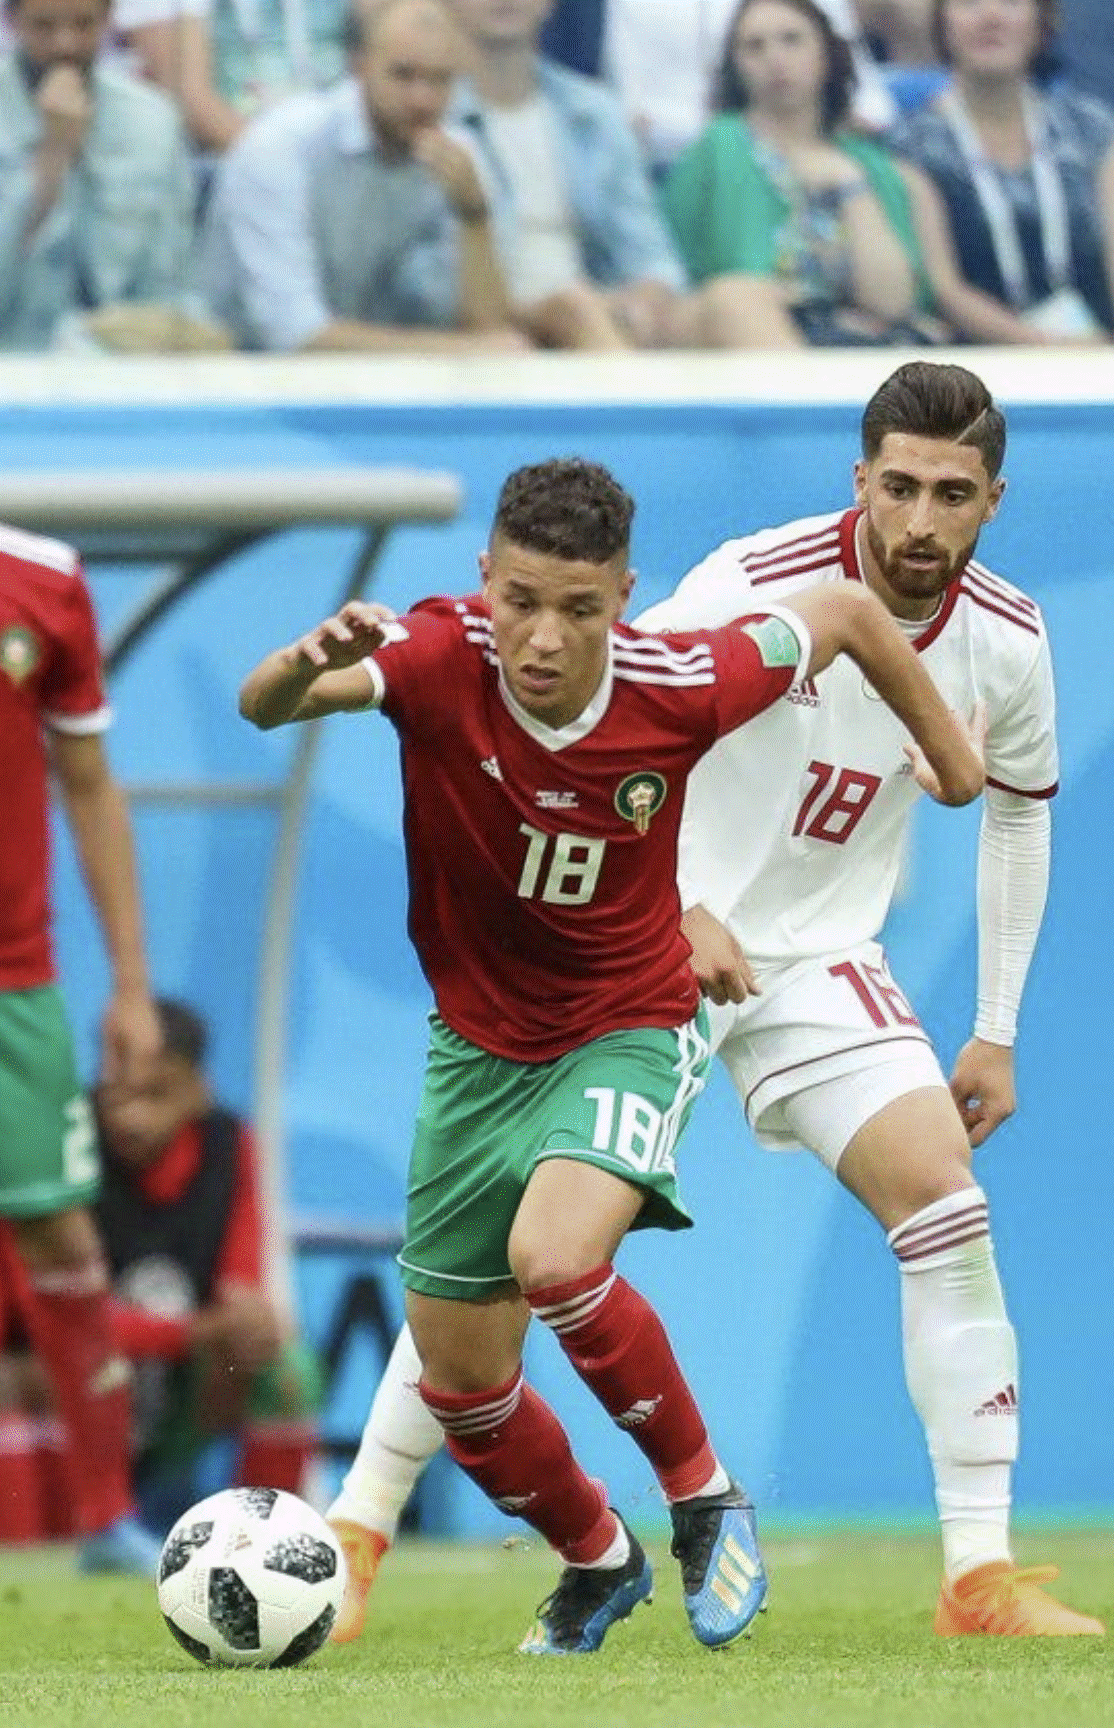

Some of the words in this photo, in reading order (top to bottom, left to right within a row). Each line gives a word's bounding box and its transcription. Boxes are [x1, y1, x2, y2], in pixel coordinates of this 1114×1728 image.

[791, 759, 883, 845] 18
[517, 822, 607, 905] 18
[584, 1087, 662, 1173] 18
